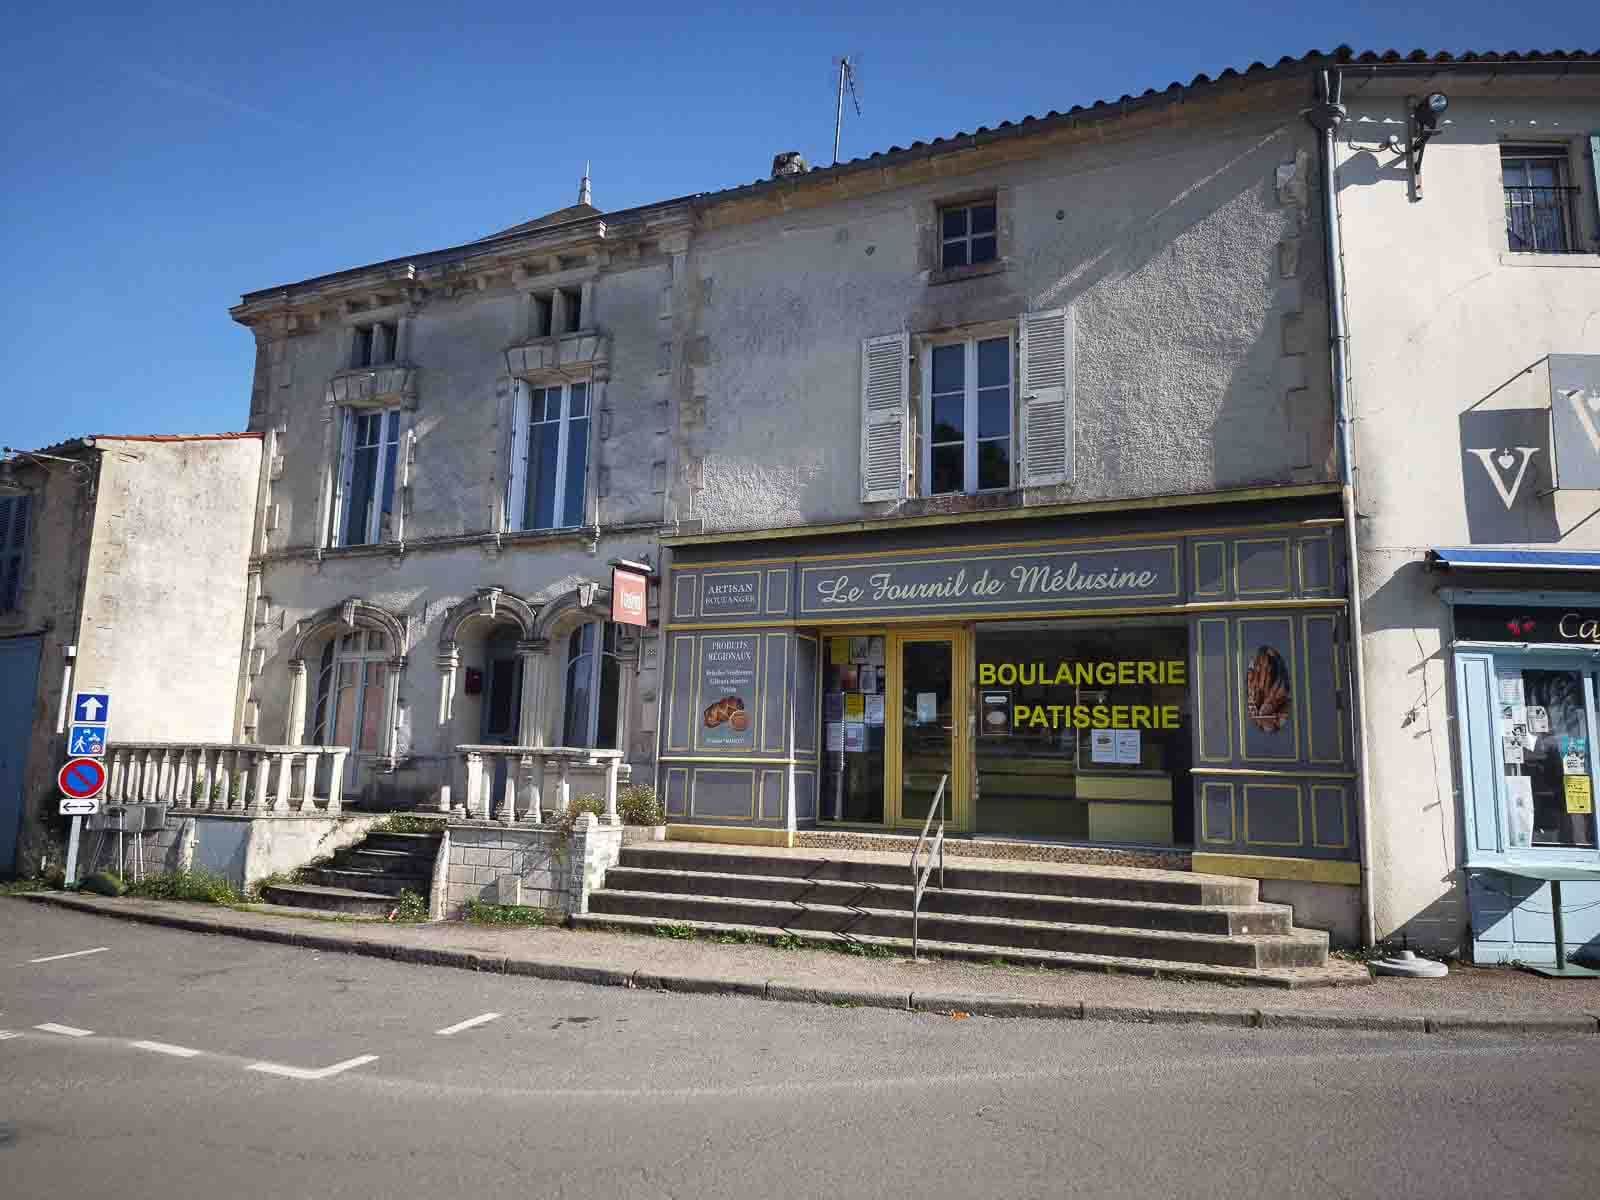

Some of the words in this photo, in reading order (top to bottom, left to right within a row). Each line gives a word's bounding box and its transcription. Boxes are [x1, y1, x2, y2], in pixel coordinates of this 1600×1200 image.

[708, 583, 753, 594] ARTISAN
[817, 575, 864, 602] Le
[869, 568, 968, 601] Fournil
[972, 568, 1006, 596] de
[1009, 560, 1159, 593] Mélusine
[712, 639, 748, 651] PRODUITS
[978, 660, 1185, 686] BOULANGERIE
[1013, 704, 1181, 729] PATISSERIE
